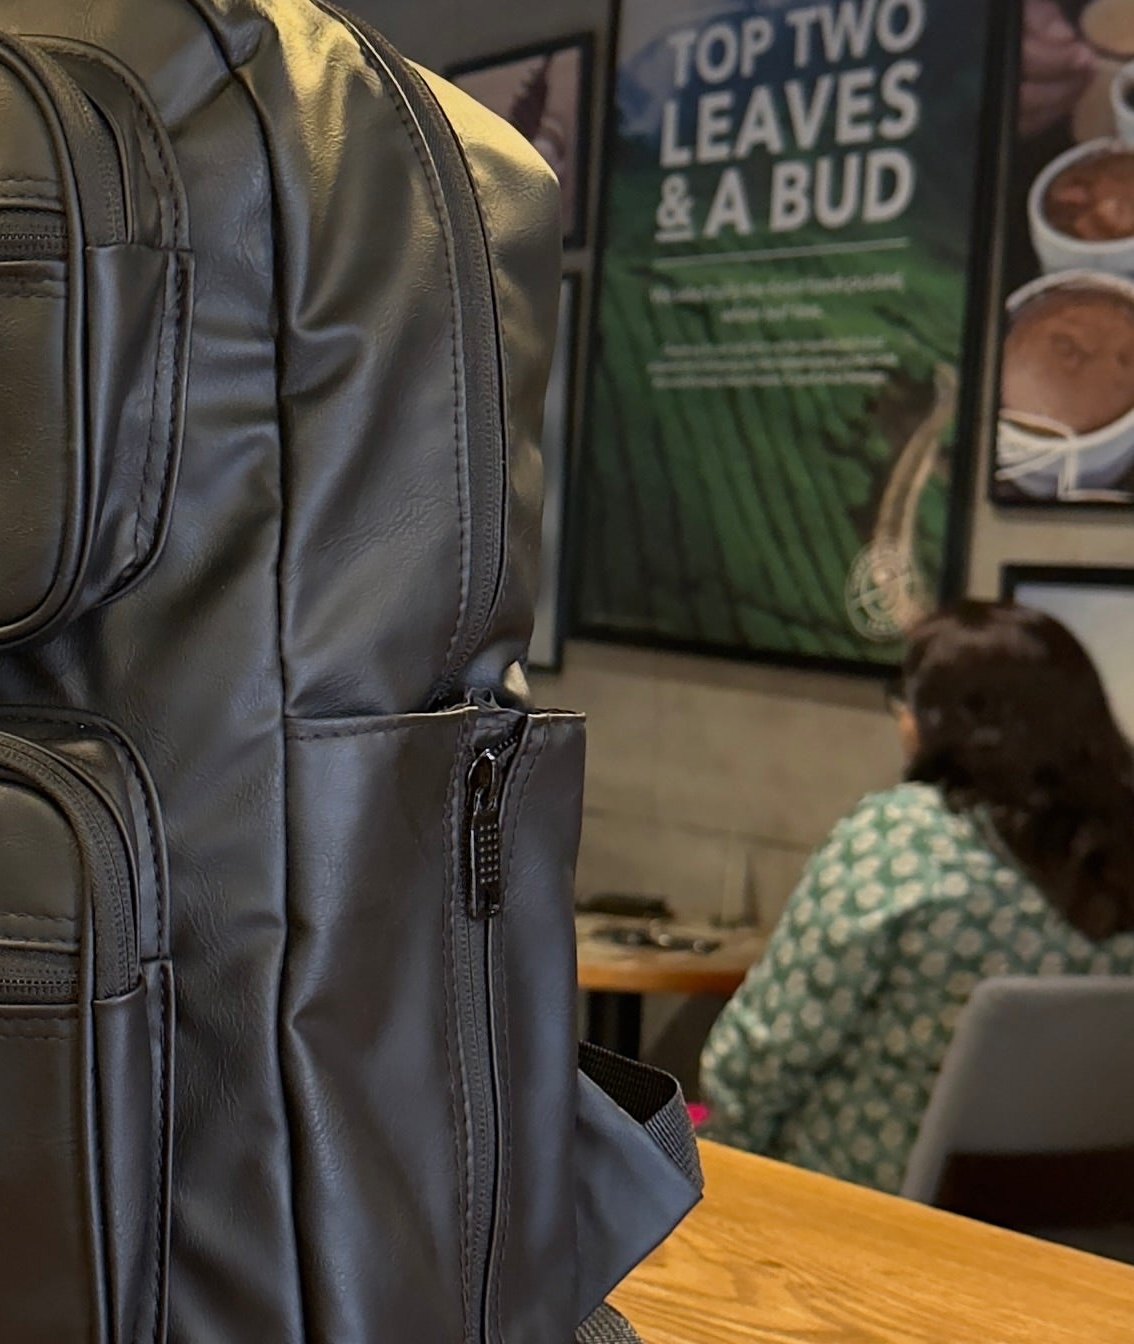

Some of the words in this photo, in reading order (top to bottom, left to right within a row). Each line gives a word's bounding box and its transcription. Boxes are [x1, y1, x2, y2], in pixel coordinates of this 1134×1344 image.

[667, 16, 773, 87] TOP
[660, 60, 922, 167] LEAVES
[703, 167, 752, 237] A
[770, 148, 914, 233] BUD
